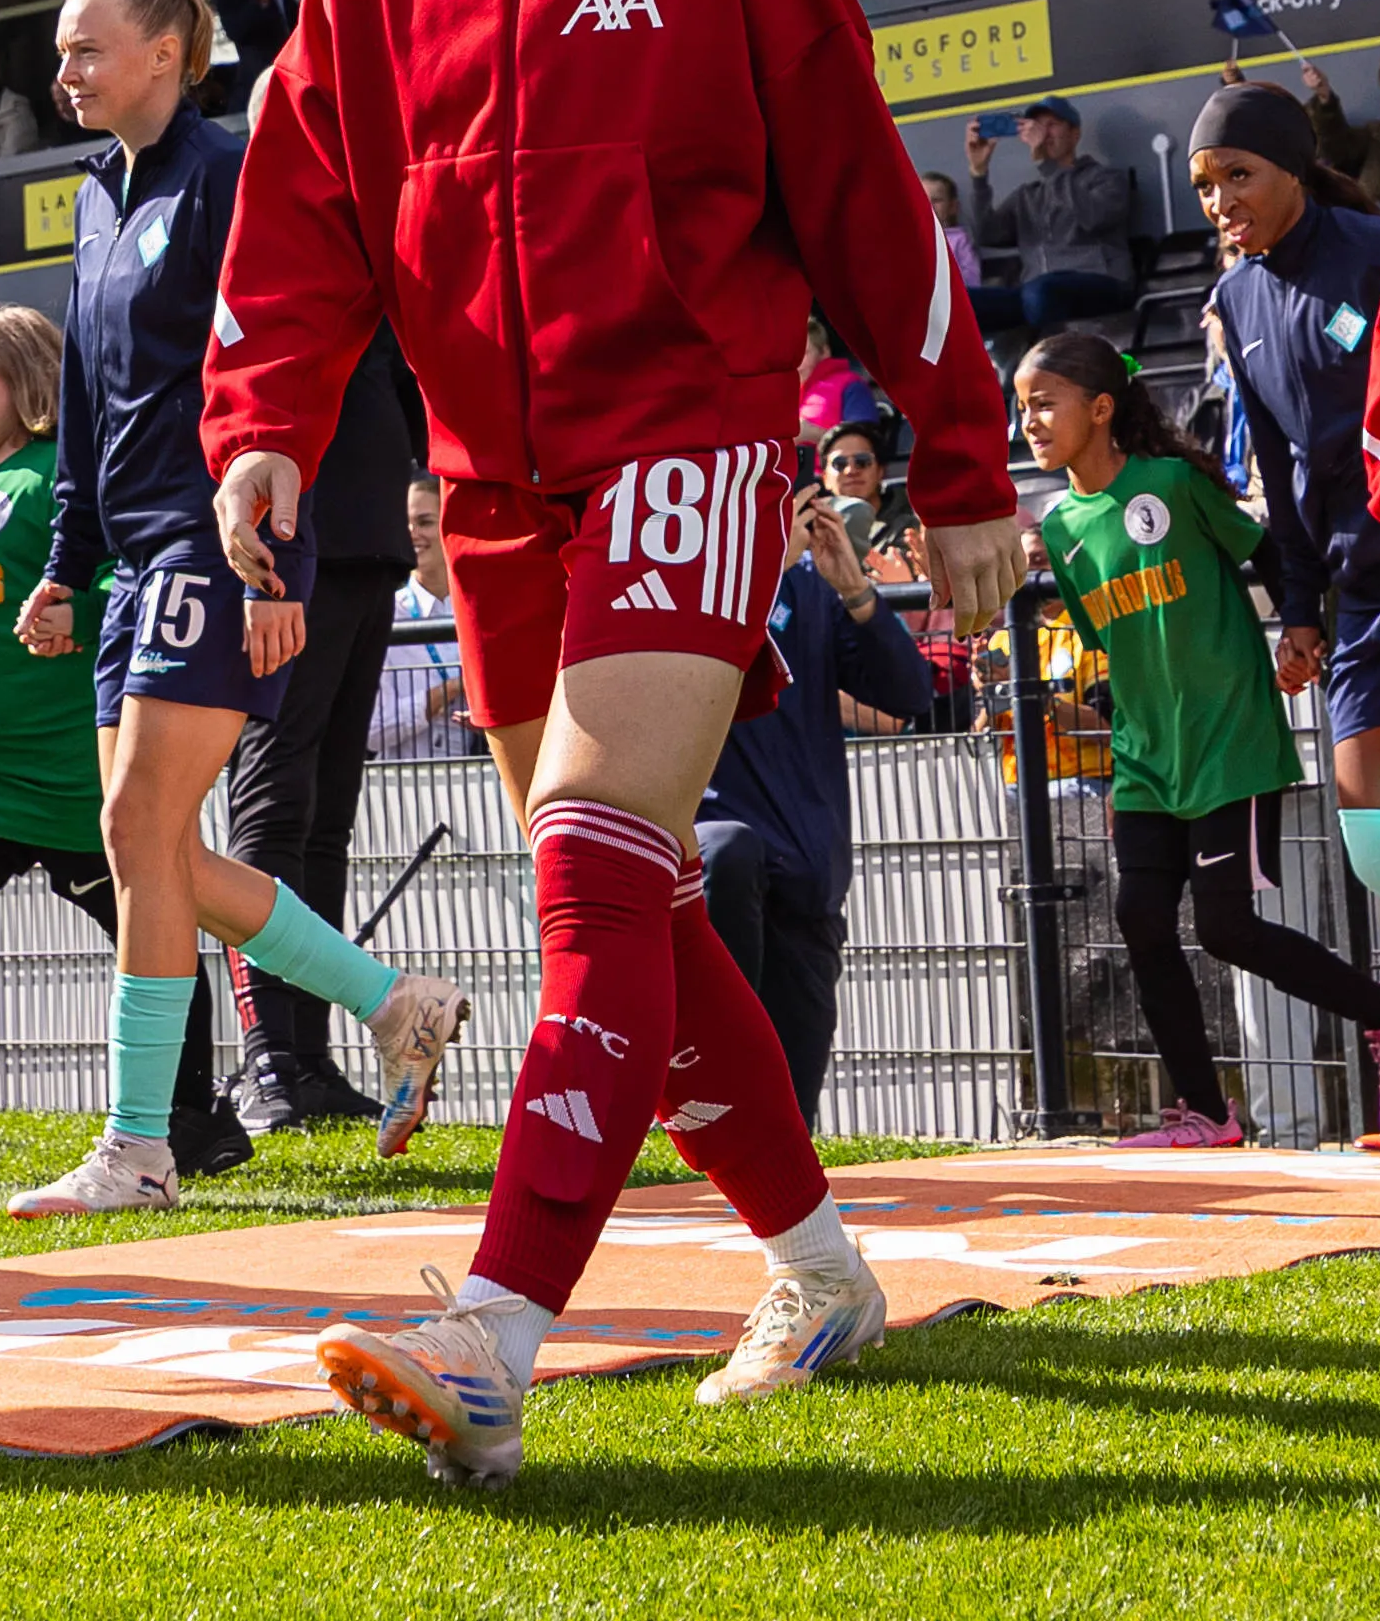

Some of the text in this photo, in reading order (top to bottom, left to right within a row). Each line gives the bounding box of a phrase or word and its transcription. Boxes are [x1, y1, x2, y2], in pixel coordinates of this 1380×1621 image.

[888, 21, 1026, 61] NGFORD
[600, 458, 705, 564] 18
[139, 570, 211, 648] 15
